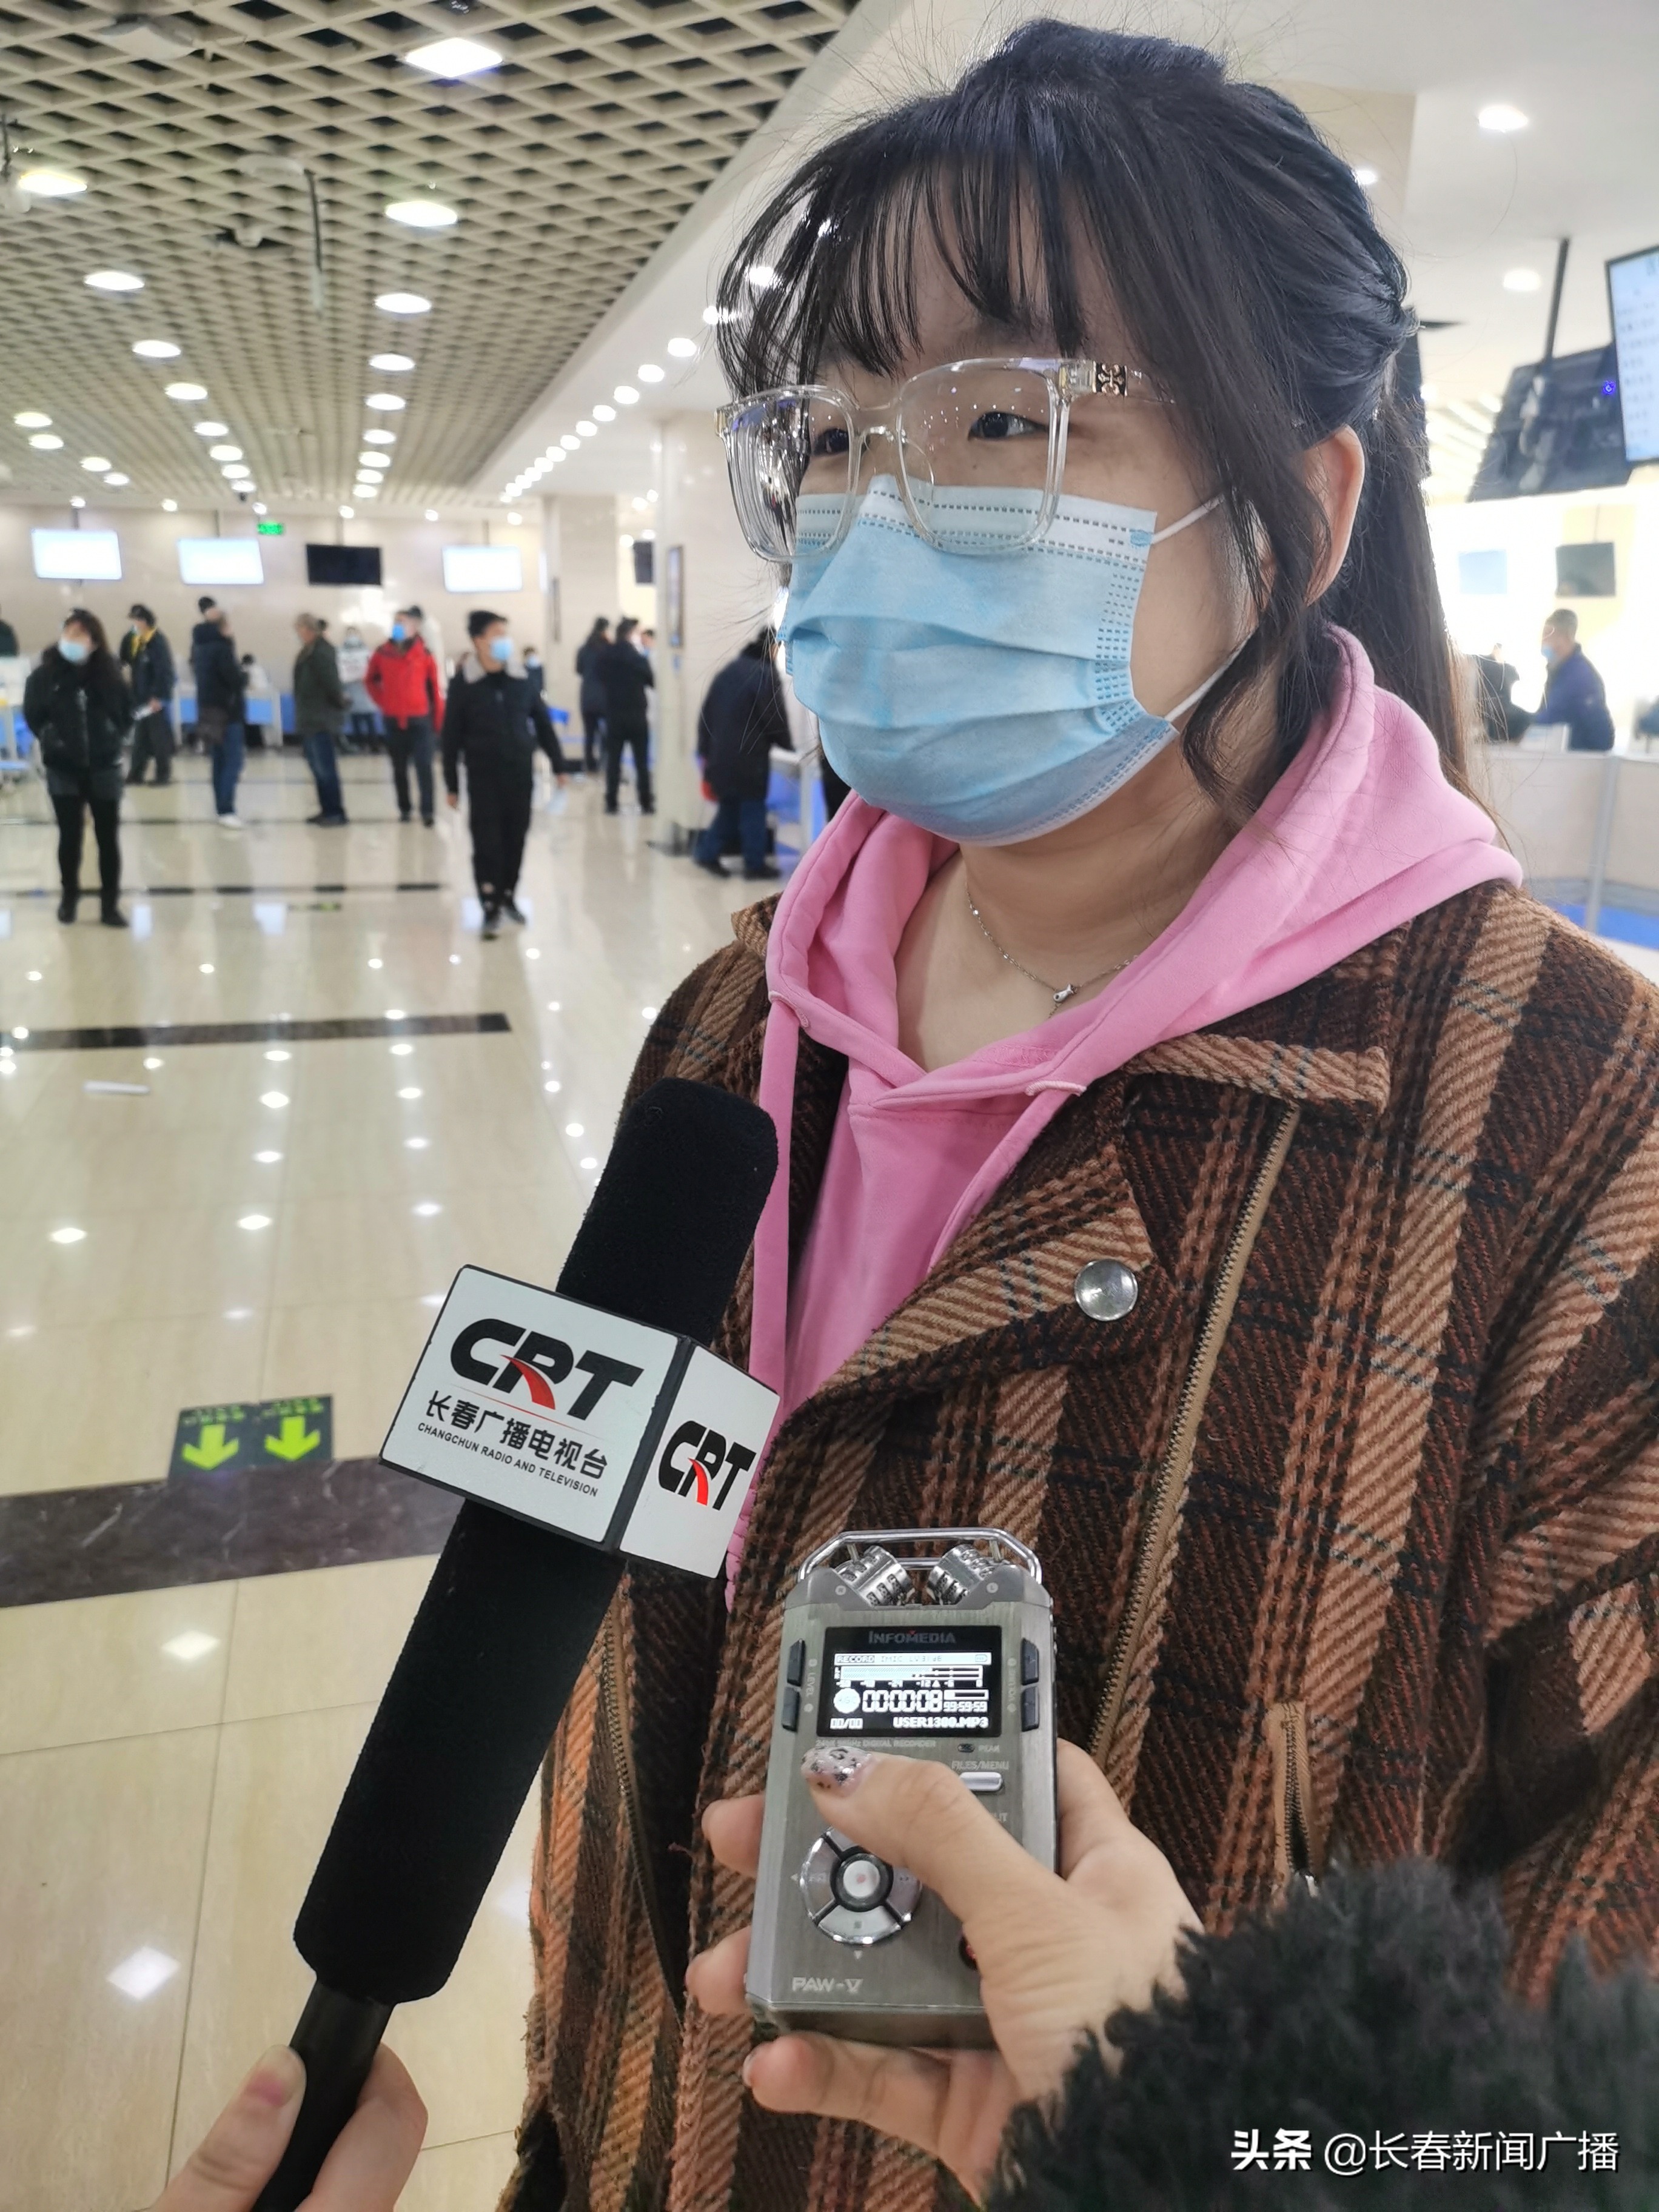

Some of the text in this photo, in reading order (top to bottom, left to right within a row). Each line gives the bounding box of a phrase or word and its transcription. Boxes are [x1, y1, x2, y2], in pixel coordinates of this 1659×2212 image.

[451, 1318, 644, 1420] CRT
[426, 1390, 607, 1479] 长春广播电视台
[418, 1423, 599, 1496] CHANGCHUN RADIO AND TELEVISION
[659, 1420, 757, 1510] CRT
[868, 1631, 956, 1644] INFOMEDIA
[806, 1672, 816, 1697] LEVEL
[943, 1701, 988, 1712] 99:59:59
[893, 1739, 936, 1748] RECORDER
[951, 1760, 1009, 1771] FILES/MENU
[792, 1976, 864, 1994] PAW-V
